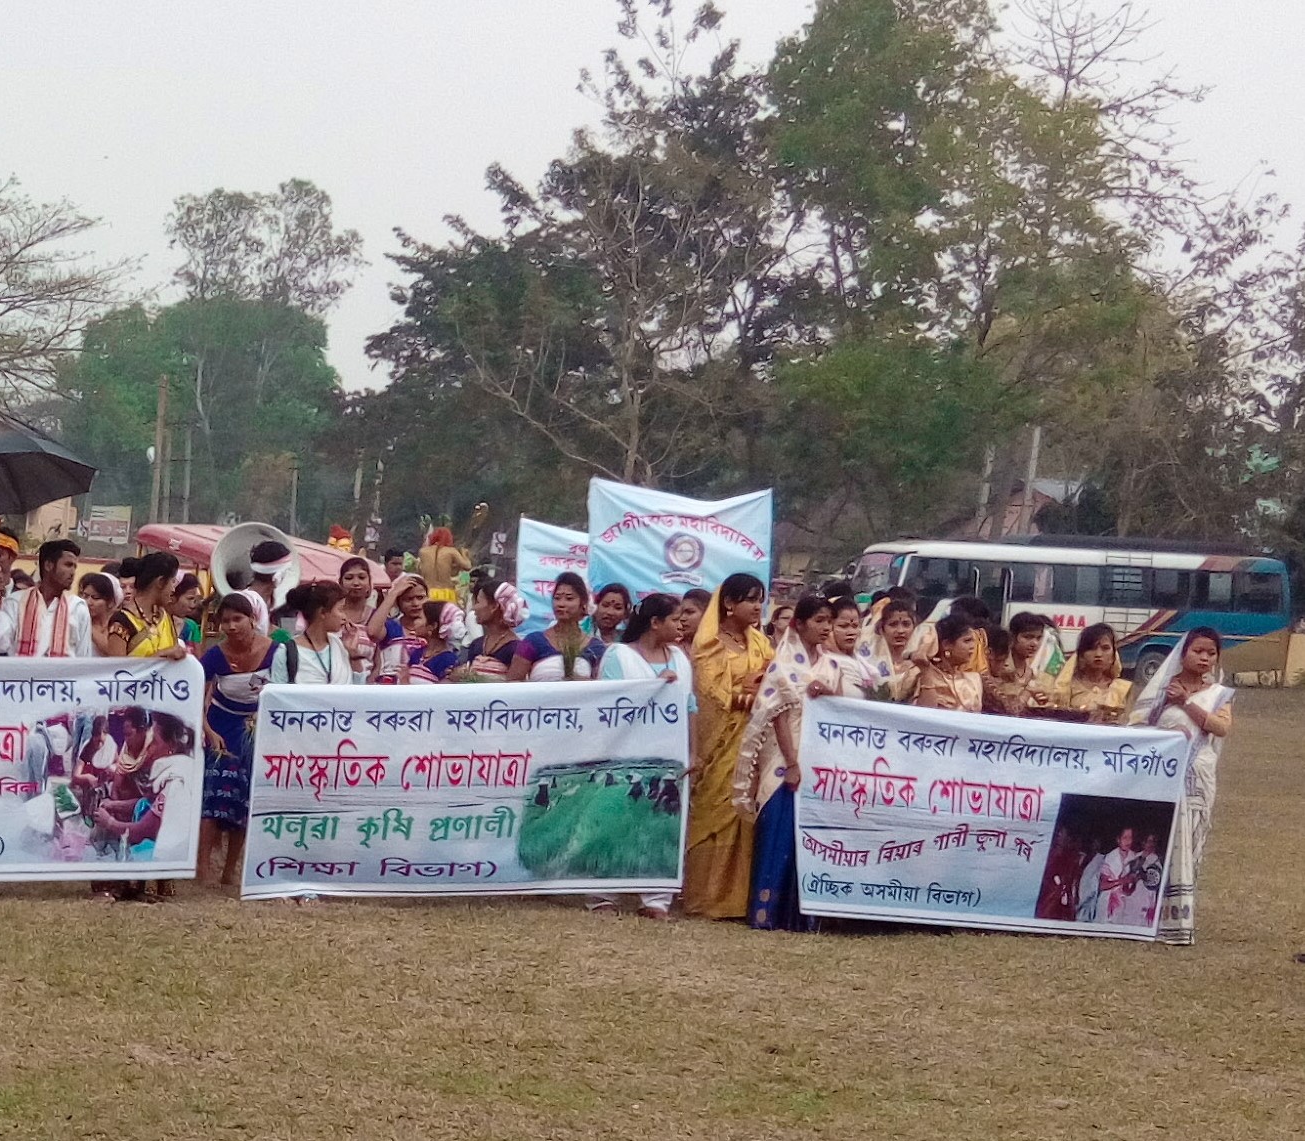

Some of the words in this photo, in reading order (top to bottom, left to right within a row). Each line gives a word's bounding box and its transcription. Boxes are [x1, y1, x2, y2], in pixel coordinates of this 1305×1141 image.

[94, 669, 191, 704] মৰিগাঁও
[268, 706, 357, 733] ঘনকান্ত
[365, 707, 434, 733] বৰুৱা
[445, 699, 584, 734] মহাবিদ্যালয়,
[816, 721, 889, 750] ঘনকান্ত
[897, 729, 959, 758] বৰুৱা
[967, 734, 1091, 774] মহাবিদ্যালয়,
[1101, 743, 1179, 778] মৰিগাঁও
[262, 738, 390, 801] সাংস্কৃতিক
[400, 749, 533, 791] শোভাযাত্ৰা
[811, 755, 918, 819] সাংস্কৃতিক
[927, 775, 1045, 824] শোভাযাত্ৰা
[355, 807, 415, 848] কৃষি
[428, 805, 518, 843] প্ৰণালী
[255, 855, 360, 879] (শিক্ষা
[379, 857, 498, 879] বিভাগ)
[860, 878, 920, 903] অসমীয়া
[925, 881, 982, 908] বিভাগ)
